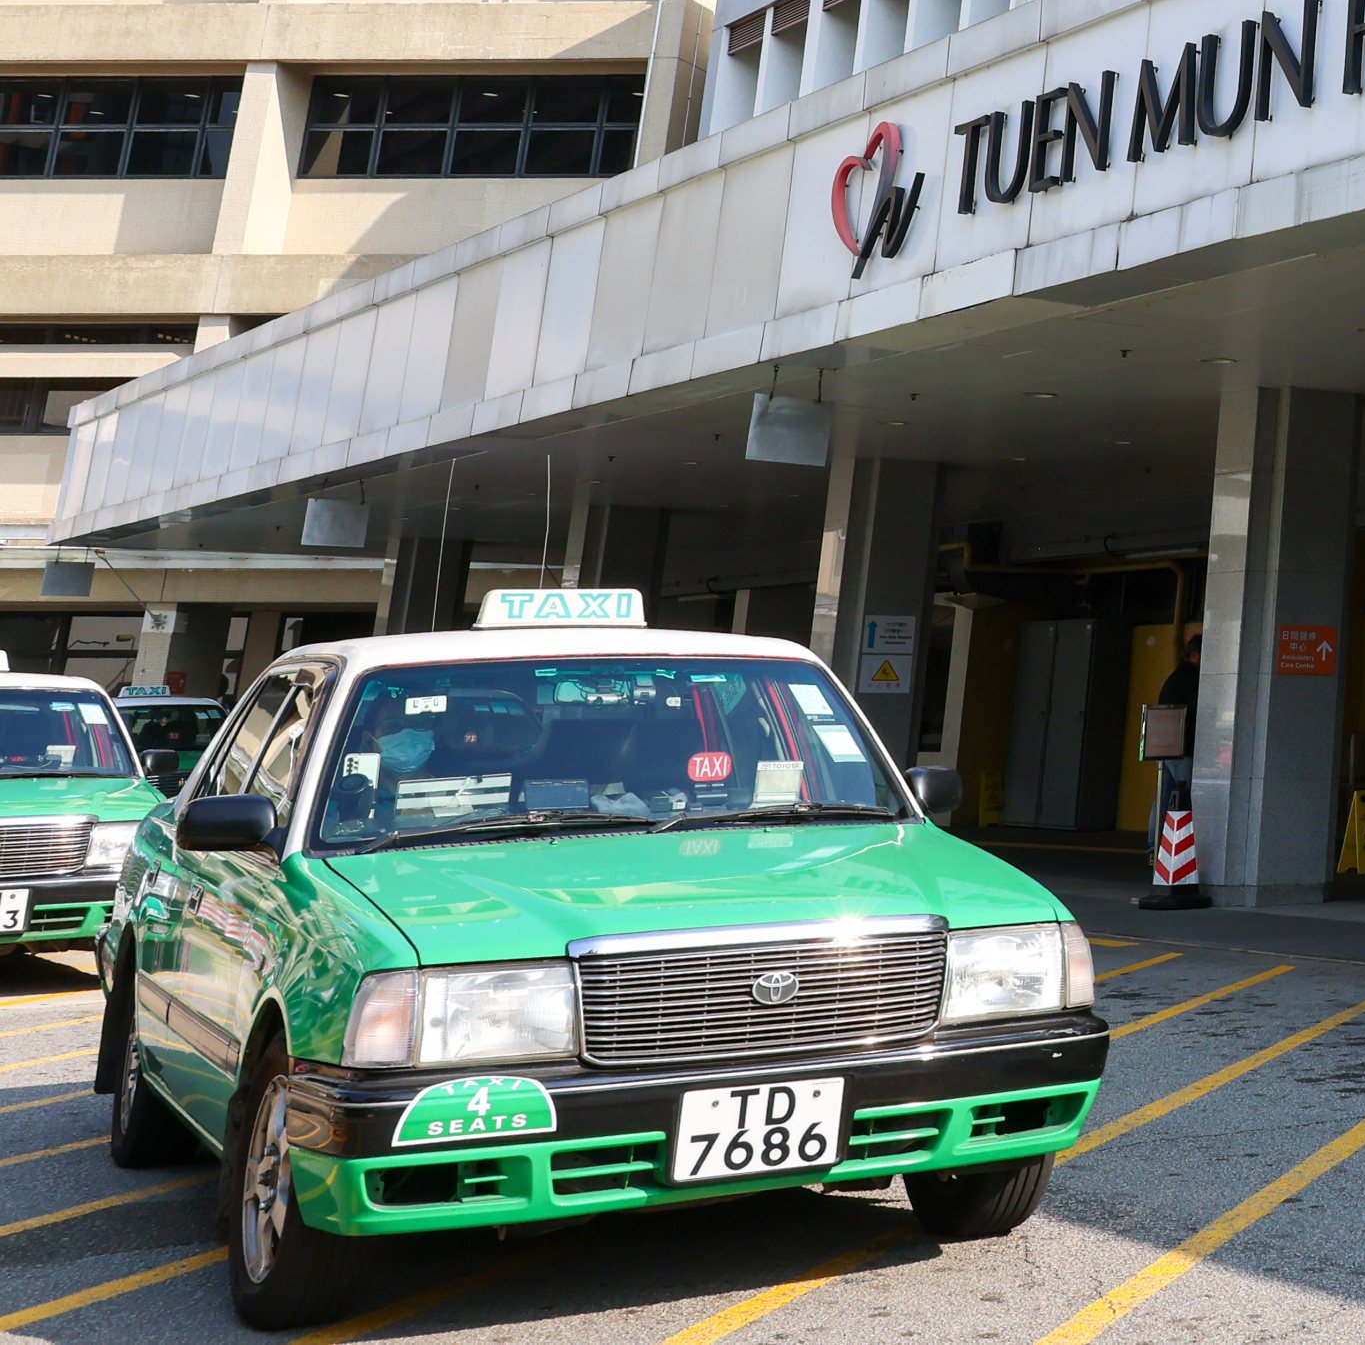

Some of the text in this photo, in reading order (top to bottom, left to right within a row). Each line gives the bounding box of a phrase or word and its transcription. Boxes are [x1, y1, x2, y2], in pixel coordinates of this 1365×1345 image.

[954, 69, 1118, 215] TUEN
[501, 592, 633, 619] TAXI
[1281, 654, 1315, 663] Ambulatory
[1290, 642, 1307, 652] 中心
[1280, 661, 1294, 669] Care
[126, 686, 167, 696] TAXI
[693, 755, 729, 778] TAXI
[772, 762, 800, 770] TOYOTA
[441, 1078, 522, 1096] TAXI
[466, 1086, 491, 1116] 4
[730, 1086, 796, 1130] TD
[427, 1113, 528, 1136] SEATS
[689, 1121, 827, 1177] 7686
